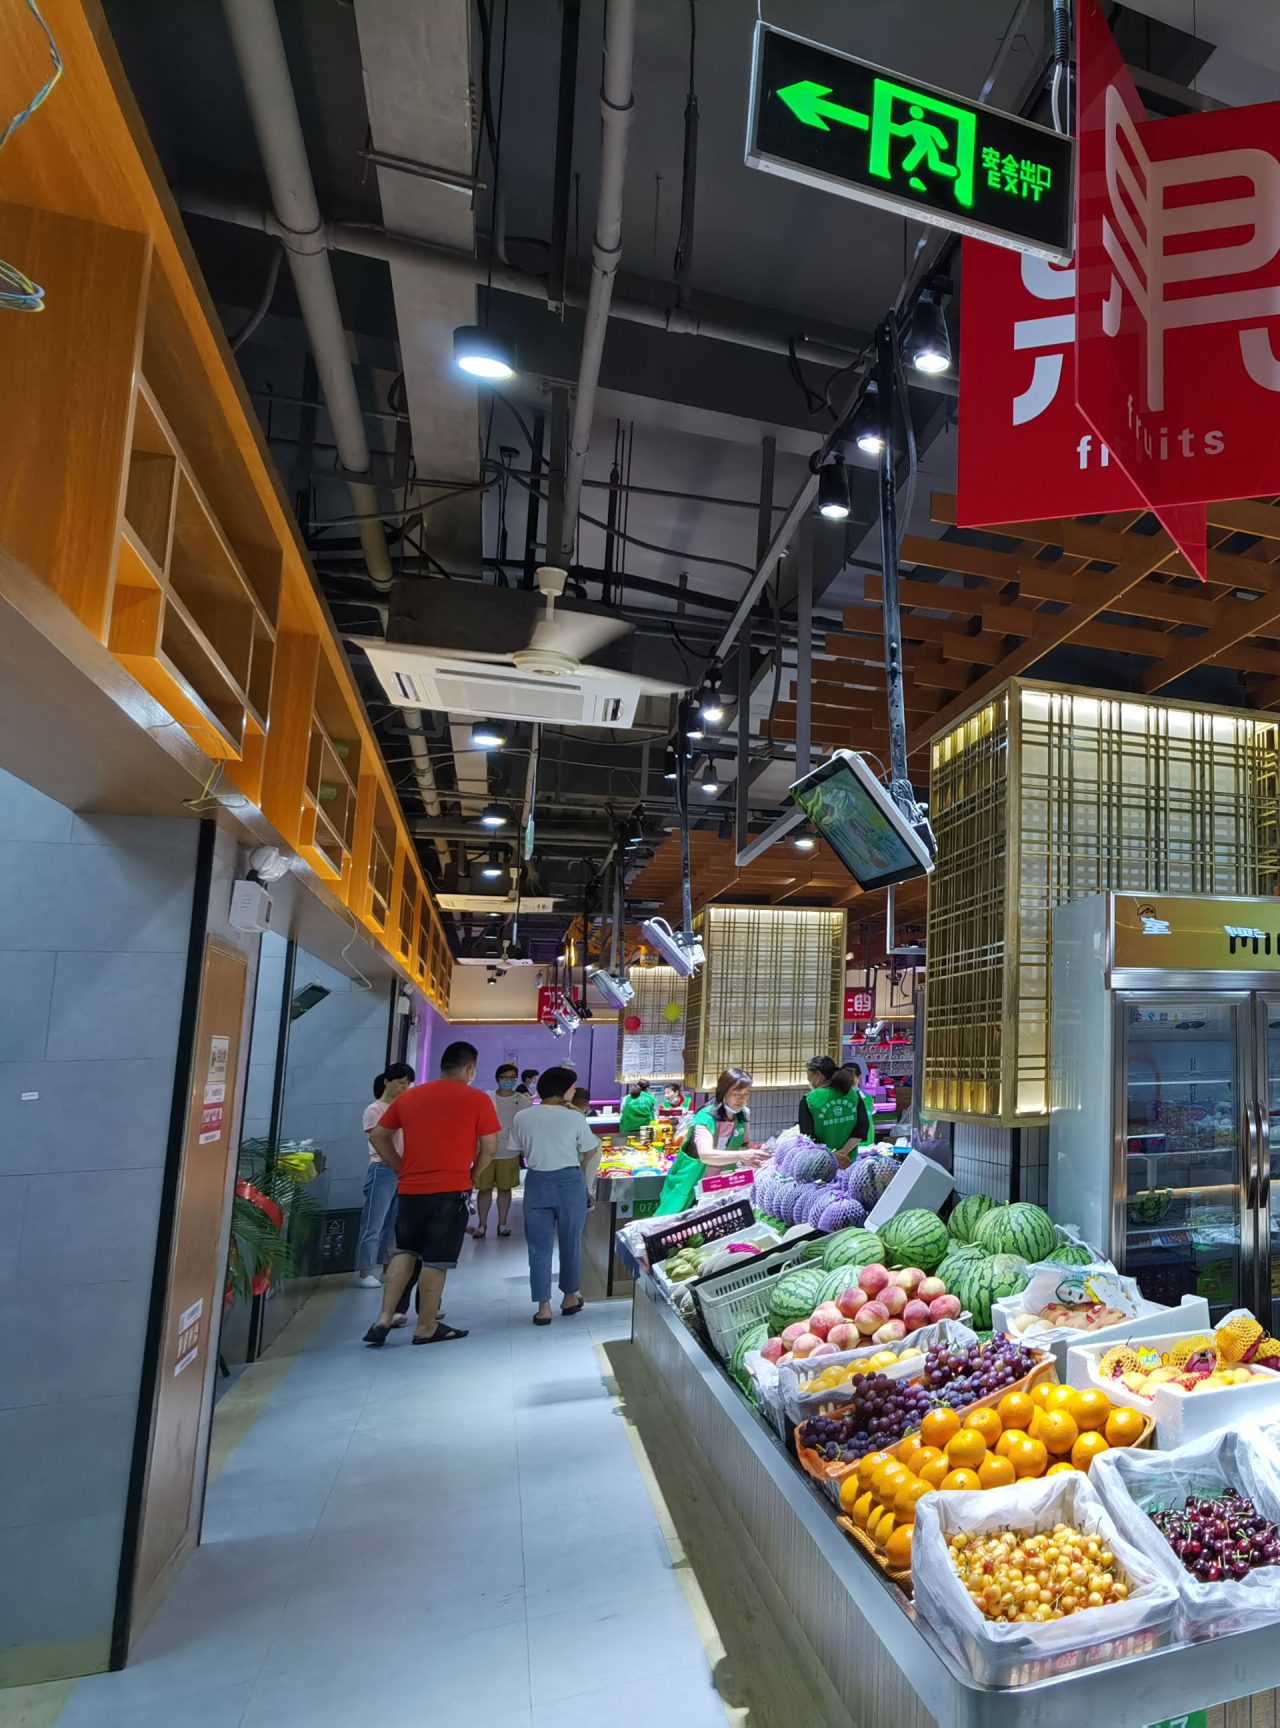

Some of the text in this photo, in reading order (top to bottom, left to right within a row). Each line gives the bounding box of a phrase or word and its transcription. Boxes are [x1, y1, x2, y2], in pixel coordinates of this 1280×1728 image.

[982, 146, 1051, 189] 安全出口
[988, 169, 1043, 202] EXIT
